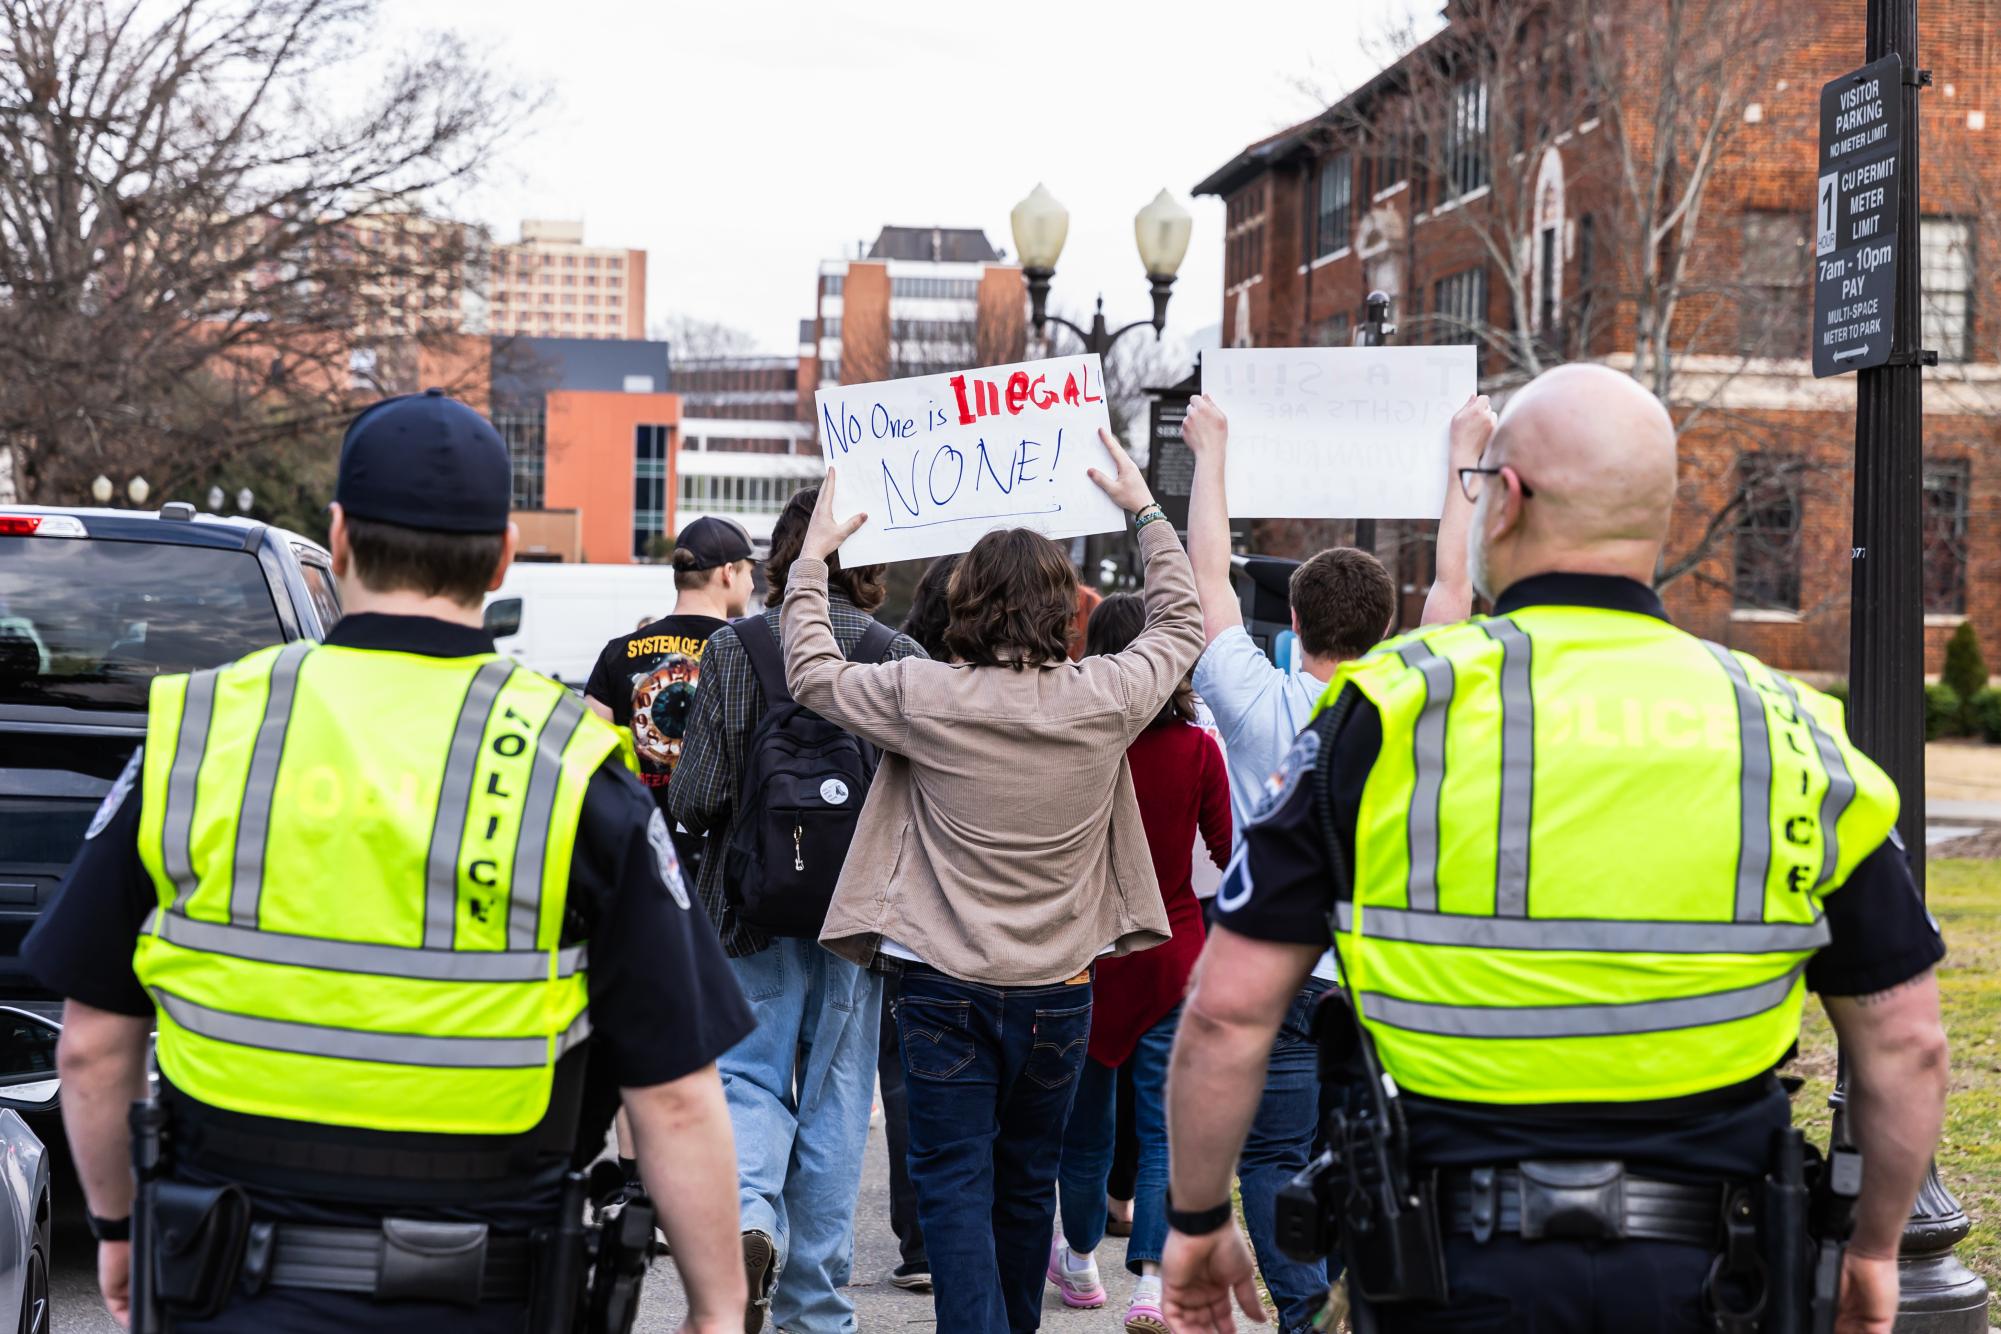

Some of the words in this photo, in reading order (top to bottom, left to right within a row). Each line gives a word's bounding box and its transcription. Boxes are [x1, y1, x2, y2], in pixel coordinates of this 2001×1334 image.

[1840, 79, 1879, 111] VISITOR
[1836, 99, 1883, 135] PARKING
[1829, 142, 1840, 159] NO
[1840, 132, 1866, 155] METER
[1867, 123, 1888, 145] LIMIT
[1841, 170, 1856, 192] CU
[1857, 157, 1896, 187] PERMIT
[1822, 182, 1833, 232] 1
[1850, 187, 1884, 215] METER
[1852, 214, 1881, 240] LIMIT
[1819, 259, 1845, 283] 7am
[1856, 245, 1892, 273] 10pm
[1841, 274, 1866, 300] PAY
[1827, 298, 1879, 325] MULTI-SPACE
[1823, 327, 1848, 346] METER
[1848, 324, 1859, 340] TO
[1859, 318, 1881, 337] PARK
[823, 400, 862, 460] No
[871, 403, 918, 439] One
[928, 400, 948, 432] is
[881, 427, 1064, 525] NONE!
[627, 635, 682, 659] SYSTEM
[681, 637, 699, 656] OF
